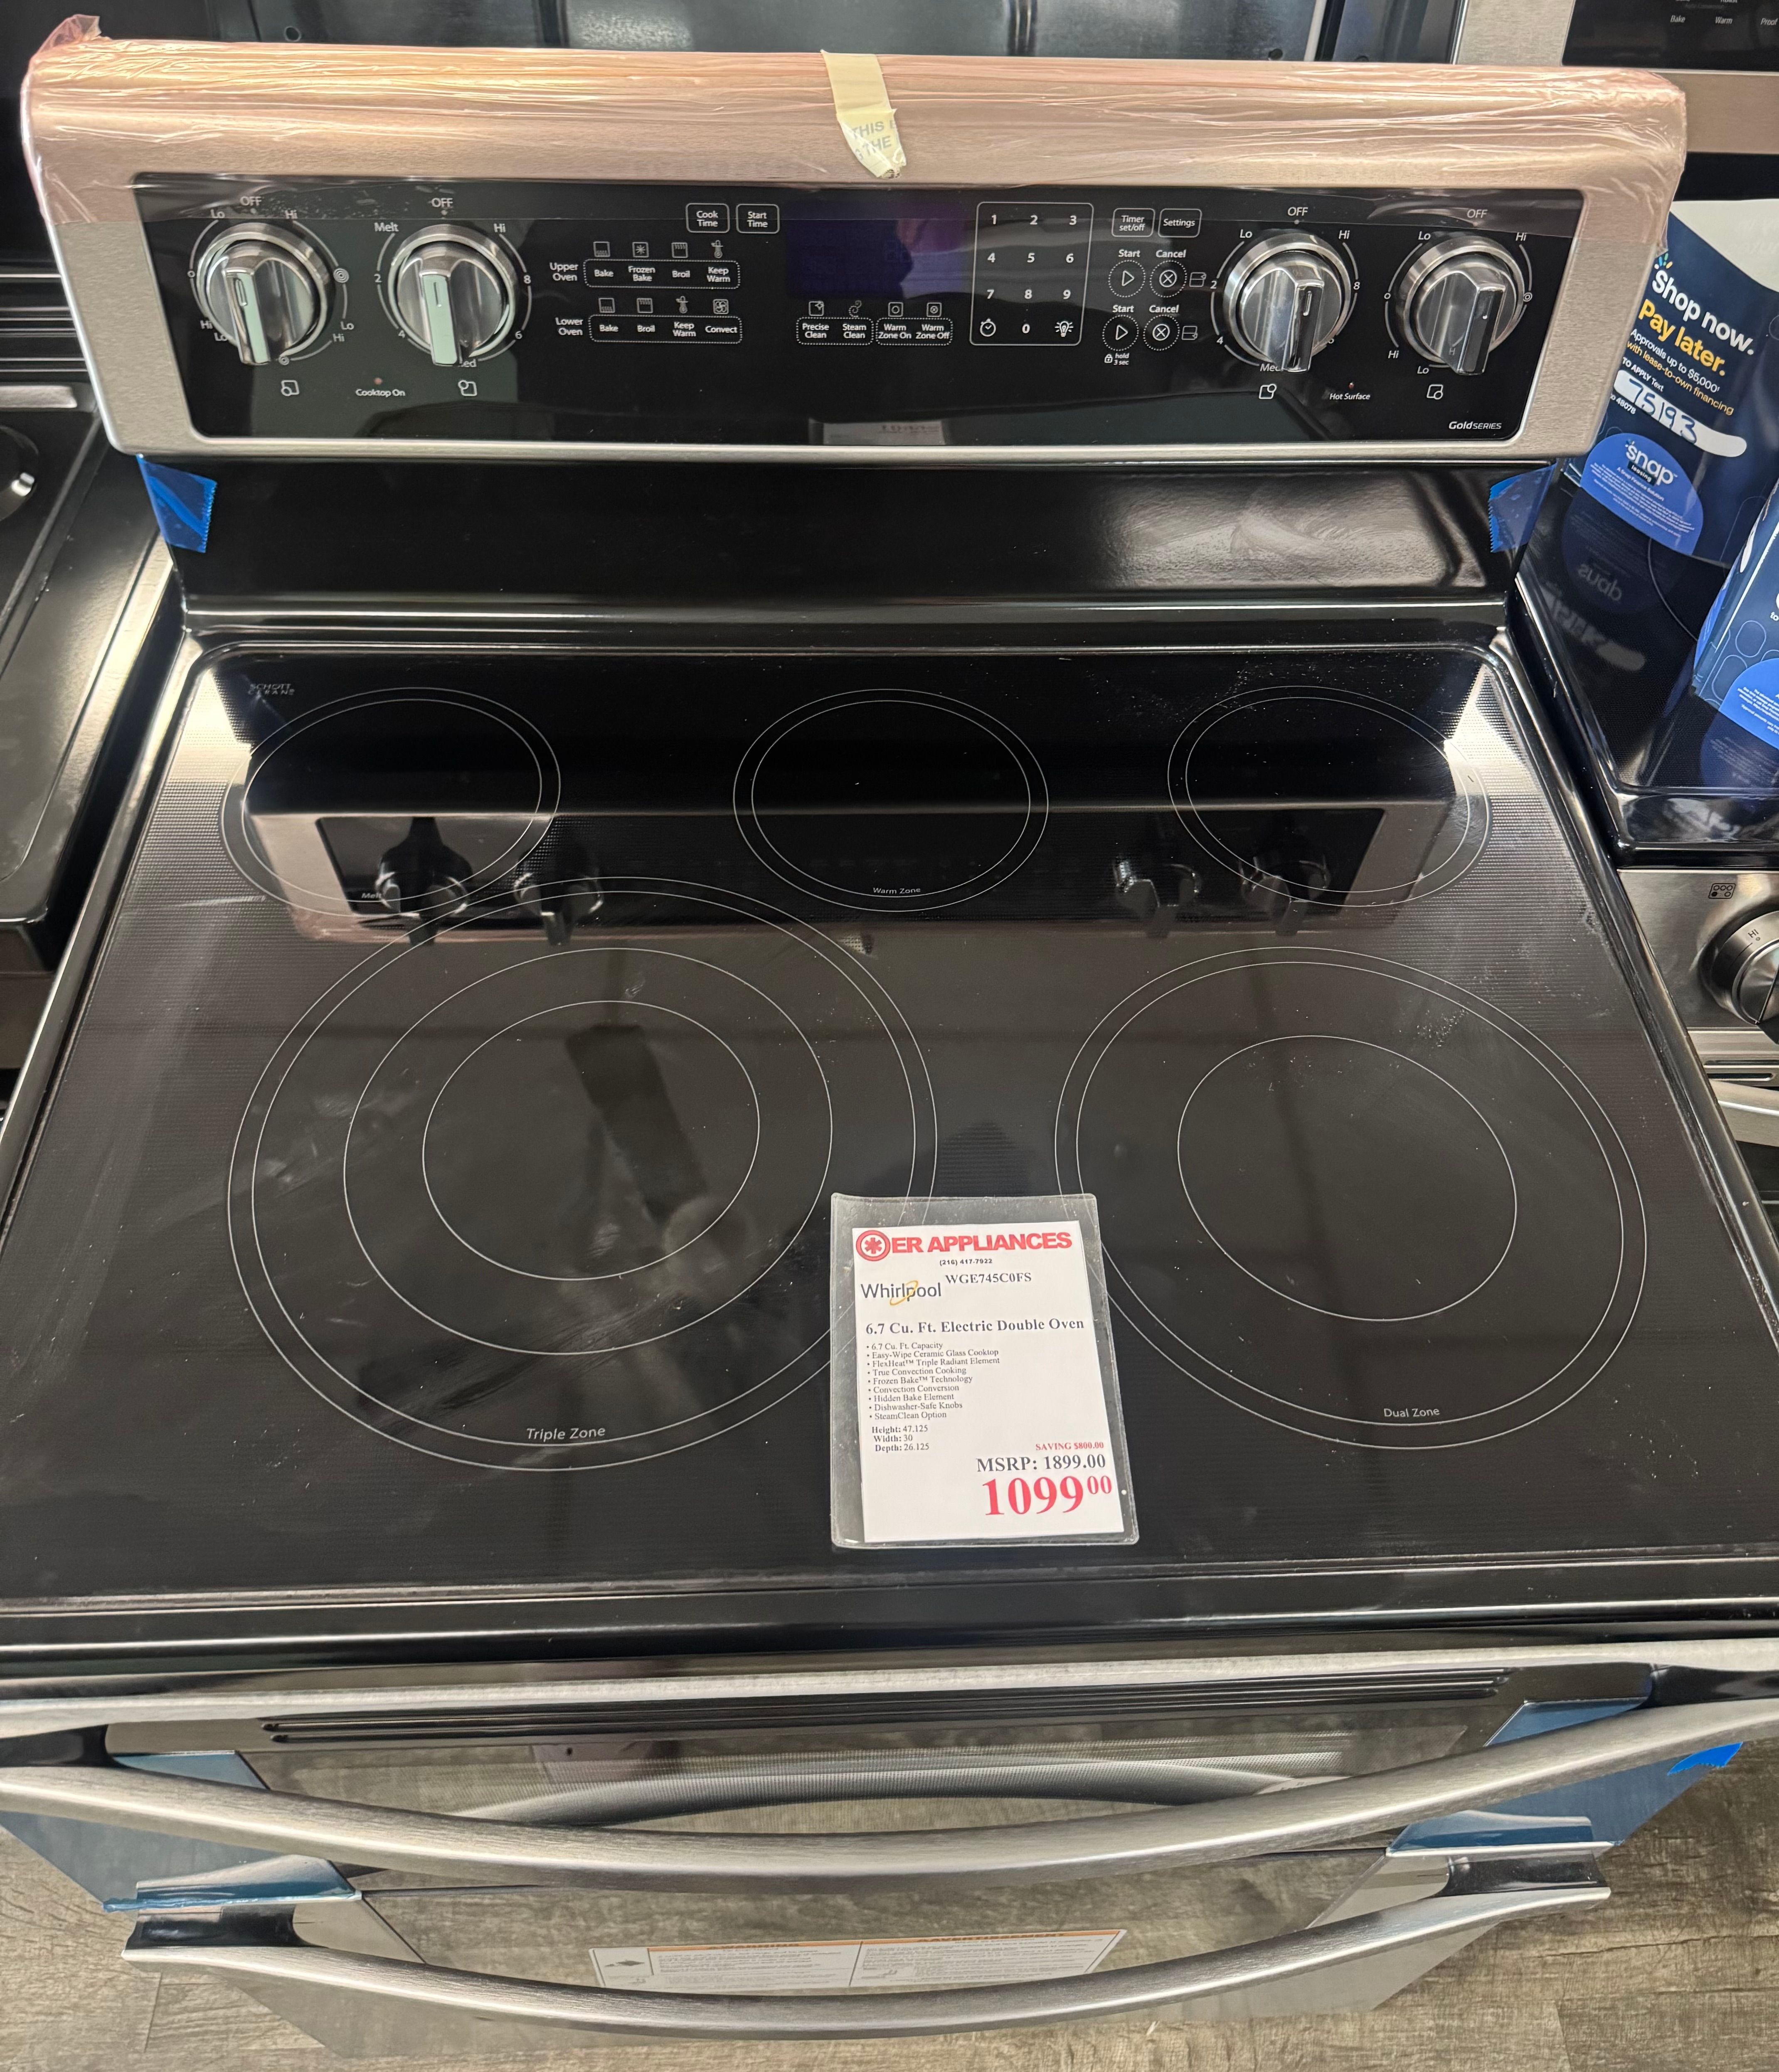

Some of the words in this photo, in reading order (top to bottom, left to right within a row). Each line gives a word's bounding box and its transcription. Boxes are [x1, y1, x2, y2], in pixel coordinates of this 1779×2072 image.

[1671, 15, 1685, 23] Bake
[1715, 16, 1733, 25] Warm
[240, 197, 262, 206] OFF
[432, 198, 453, 208] OFF
[285, 210, 298, 219] Hi
[1287, 207, 1308, 216] OFF
[1467, 209, 1487, 219] OFF
[992, 215, 996, 224] 1
[1030, 215, 1038, 225] 2
[1069, 215, 1077, 225] 3
[1163, 219, 1195, 228] Settings
[375, 222, 399, 233] Melt
[494, 223, 506, 233] Hi
[1119, 223, 1146, 232] set/off
[1240, 229, 1253, 239] Lo
[1338, 230, 1350, 239] Hi
[1418, 231, 1431, 240] Lo
[1516, 232, 1527, 241] Hi
[988, 253, 995, 263] 4
[1027, 253, 1035, 263] 5
[1066, 253, 1074, 263] 6
[1118, 249, 1141, 258] Start
[1156, 249, 1186, 258] Cancel
[549, 262, 579, 272] Upper
[708, 267, 729, 276] Keep
[987, 290, 995, 299] 7
[1024, 289, 1032, 299] 8
[1063, 290, 1071, 299] 9
[1149, 305, 1179, 314] Cancel
[1652, 270, 1700, 322] Shop
[1701, 312, 1754, 355] now.
[341, 321, 354, 330] Lo
[555, 317, 583, 325] Lower
[674, 322, 694, 330] Keep
[1022, 324, 1030, 334] 0
[558, 327, 583, 336] Oven
[333, 334, 345, 342] Hi
[1638, 299, 1676, 342] Pay
[1675, 326, 1725, 376] later.
[1388, 350, 1399, 359] Hi
[1630, 328, 1666, 359] Approvals
[1667, 357, 1678, 368] up
[1678, 362, 1687, 374] to
[1417, 366, 1429, 374] Lo
[1622, 357, 1631, 367] TO
[1631, 364, 1651, 380] APPLY
[1651, 377, 1665, 392] Text
[1627, 341, 1643, 356] with
[1643, 351, 1693, 392] lease-to-own
[1693, 387, 1735, 416] financing
[355, 389, 391, 398] Cooktop
[1616, 397, 1637, 415] 48078
[1631, 465, 1652, 482] leasing
[892, 1237, 924, 1253] ER
[927, 1232, 1072, 1253] APPLIANCES
[945, 1272, 1032, 1284] WGE745C0FS
[861, 1282, 941, 1302] Whirlpool
[866, 1323, 885, 1334] 6.7
[890, 1322, 913, 1334] Cu.
[918, 1321, 936, 1333] Ft.
[941, 1320, 993, 1332] Electric
[997, 1319, 1045, 1331] Double
[1049, 1318, 1084, 1329] Oven
[912, 1341, 943, 1350] Capacity
[872, 1351, 912, 1360] Easy-Wipe
[968, 1349, 999, 1357] Cooktop
[916, 1358, 938, 1367] Triple
[930, 1375, 973, 1383] Technology
[875, 1402, 936, 1411] Dishwasher-Safe
[921, 1411, 947, 1420] Option
[1384, 1408, 1409, 1417] Dual
[1412, 1408, 1440, 1417] Zone
[527, 1428, 565, 1442] Triple
[569, 1427, 605, 1439] Zone
[872, 1426, 901, 1435] Height:
[875, 1444, 902, 1453] Depth:
[1035, 1442, 1072, 1451] SAVING
[1074, 1441, 1104, 1450] $800.00
[977, 1457, 1038, 1472] MSRP:
[1044, 1454, 1106, 1470] 1899.00
[982, 1475, 1084, 1516] 1099
[1087, 1475, 1112, 1495] 00
